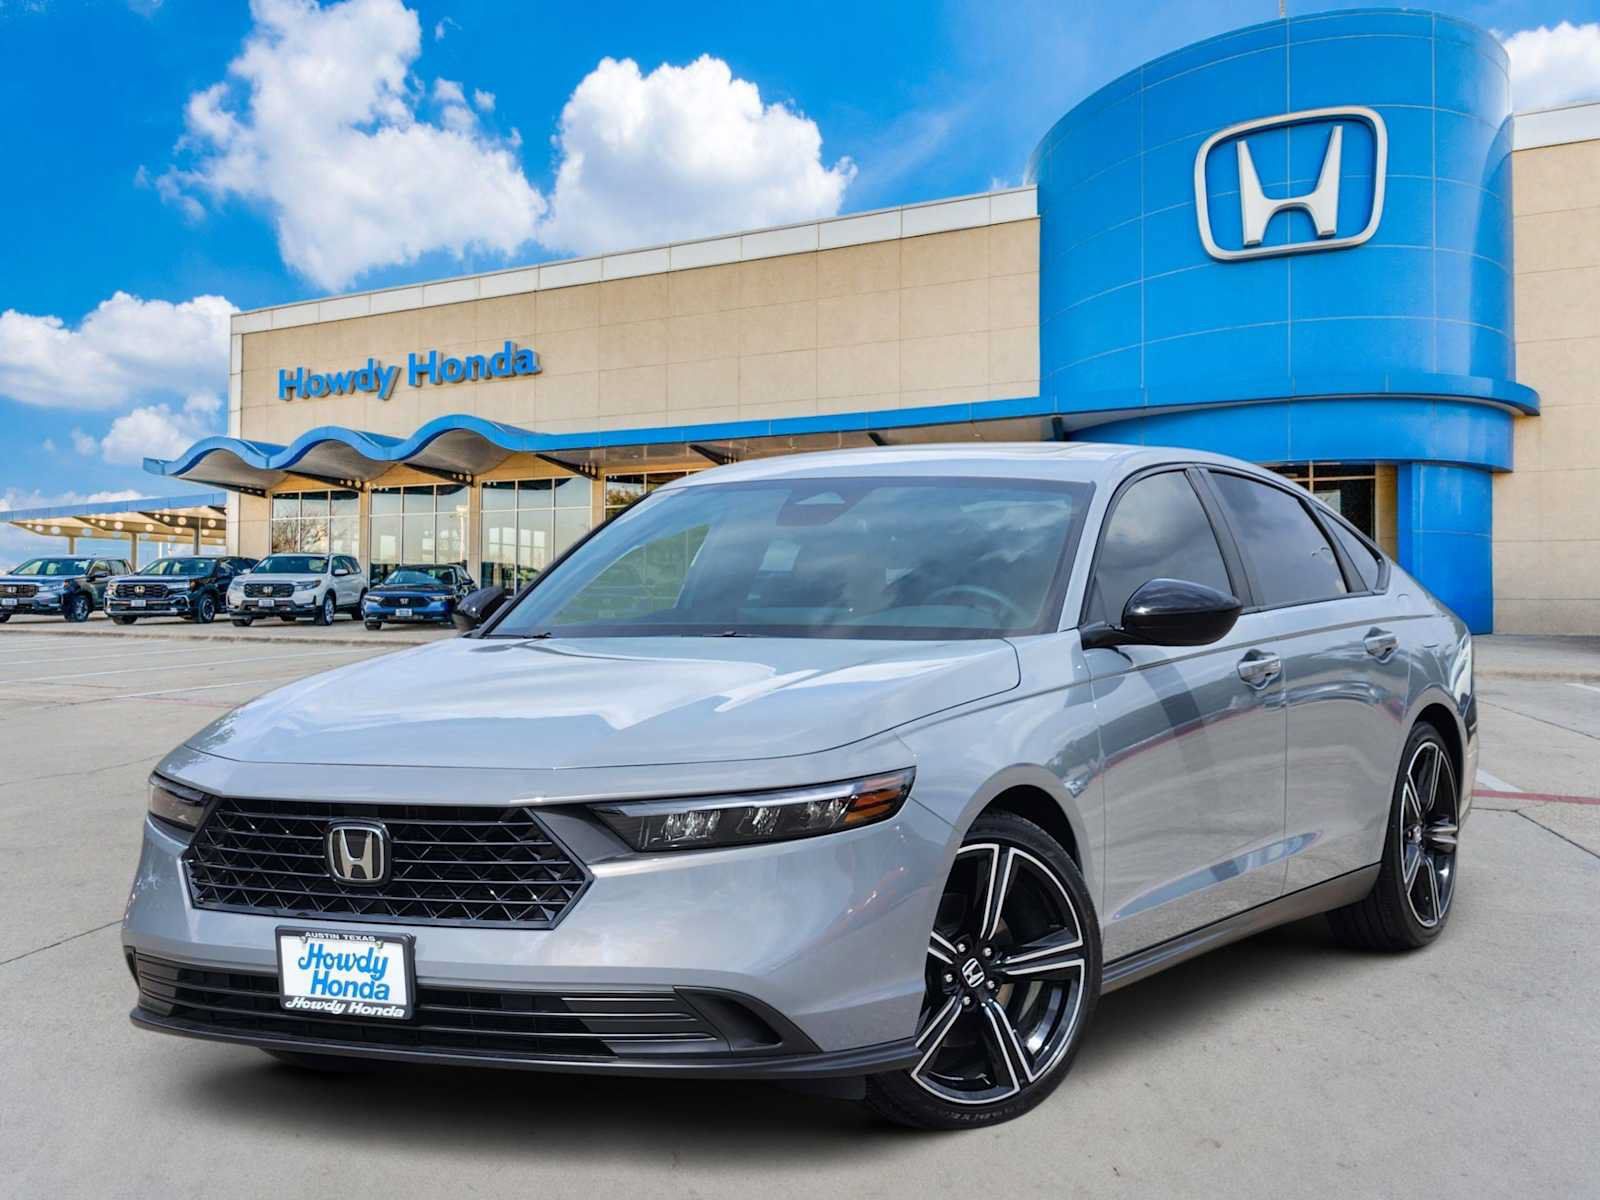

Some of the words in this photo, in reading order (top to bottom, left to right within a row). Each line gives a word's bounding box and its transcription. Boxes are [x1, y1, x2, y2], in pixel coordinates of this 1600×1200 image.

[278, 358, 400, 400] Howdy
[408, 341, 541, 388] Honda
[305, 931, 340, 940] AUSTIN
[343, 934, 376, 942] TEXAS
[298, 943, 388, 980] Howdy
[310, 970, 390, 1001] Honda
[285, 997, 346, 1014] Howdy
[348, 1002, 405, 1017] Honda
